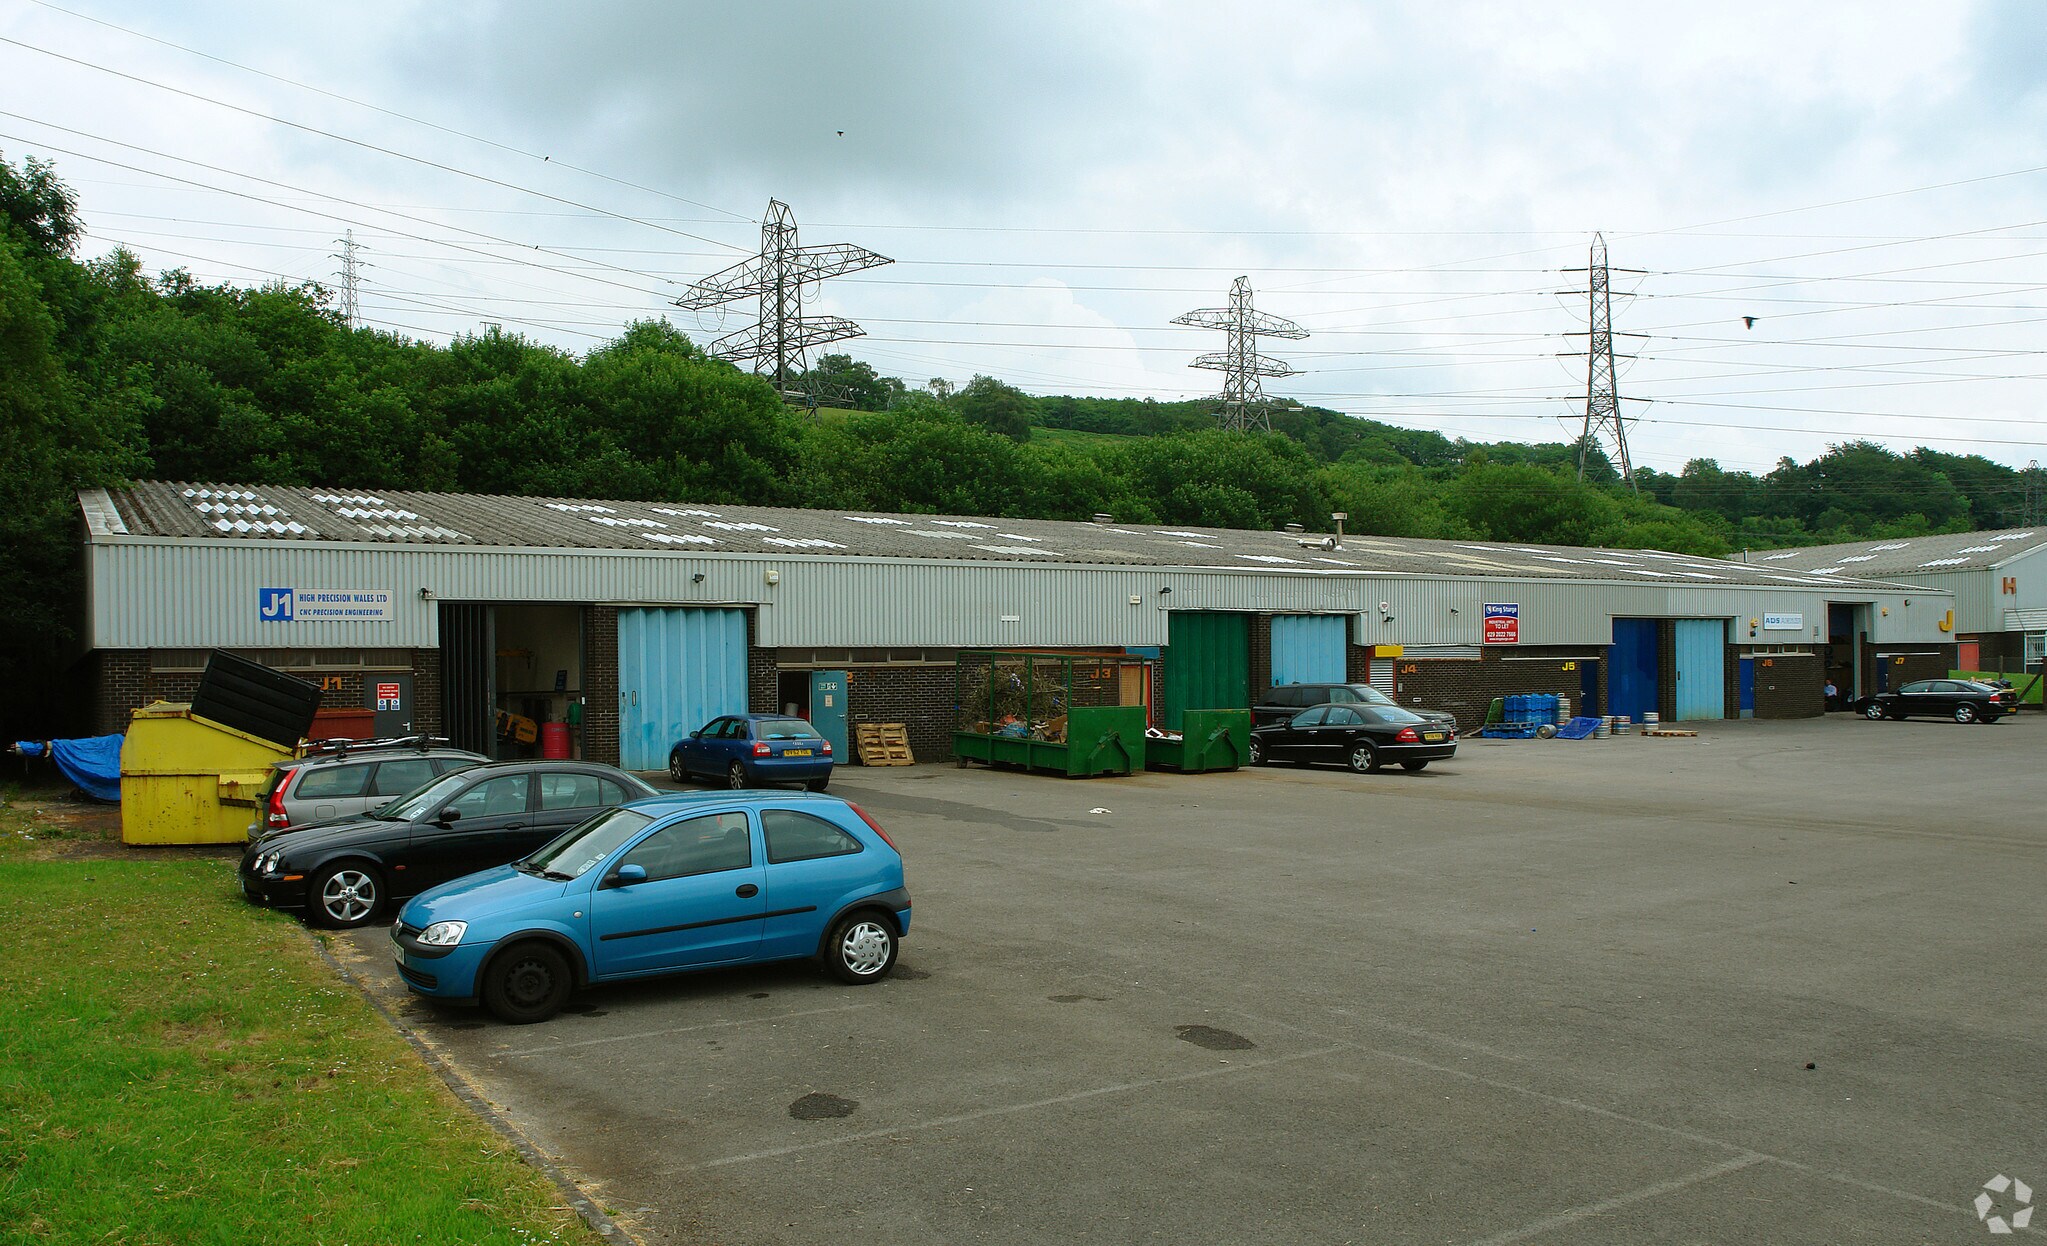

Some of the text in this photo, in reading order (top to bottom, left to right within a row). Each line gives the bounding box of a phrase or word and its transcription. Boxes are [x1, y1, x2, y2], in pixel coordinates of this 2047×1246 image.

[2003, 577, 2017, 594] H
[299, 594, 388, 603] HIGH PRECISION WALES LTD
[262, 593, 292, 617] J1
[1492, 605, 1517, 614] King Sturge
[1938, 610, 1953, 632] J
[1401, 664, 1417, 674] J4
[1562, 661, 1576, 671] J5
[1090, 668, 1111, 679] J3
[320, 677, 342, 690] J1
